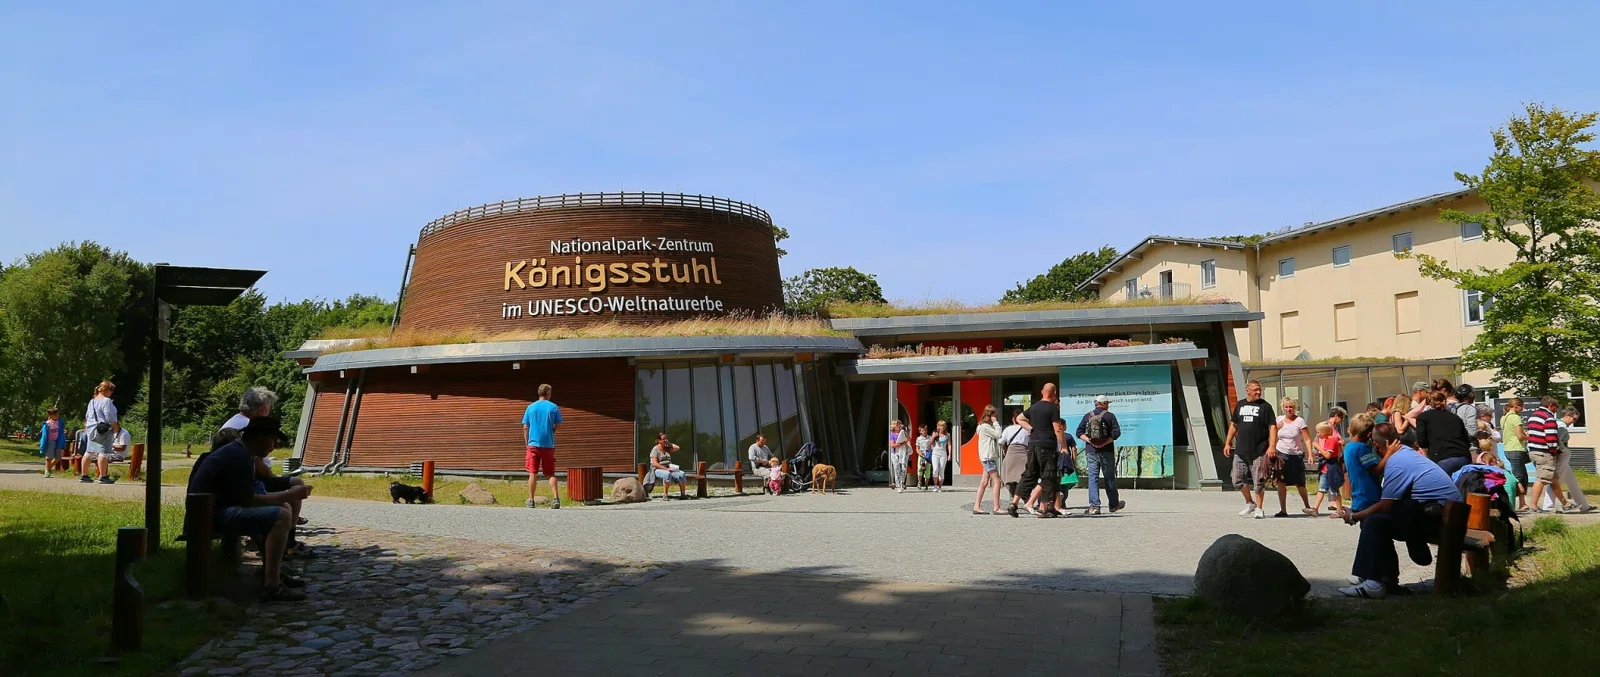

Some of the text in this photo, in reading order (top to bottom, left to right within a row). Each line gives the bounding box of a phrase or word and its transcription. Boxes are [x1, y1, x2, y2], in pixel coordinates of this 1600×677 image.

[550, 237, 714, 255] Nationalpark-Zentrum
[504, 256, 722, 292] Königsstuhl
[502, 296, 724, 318] im UNESCO-Weltnaturerbe
